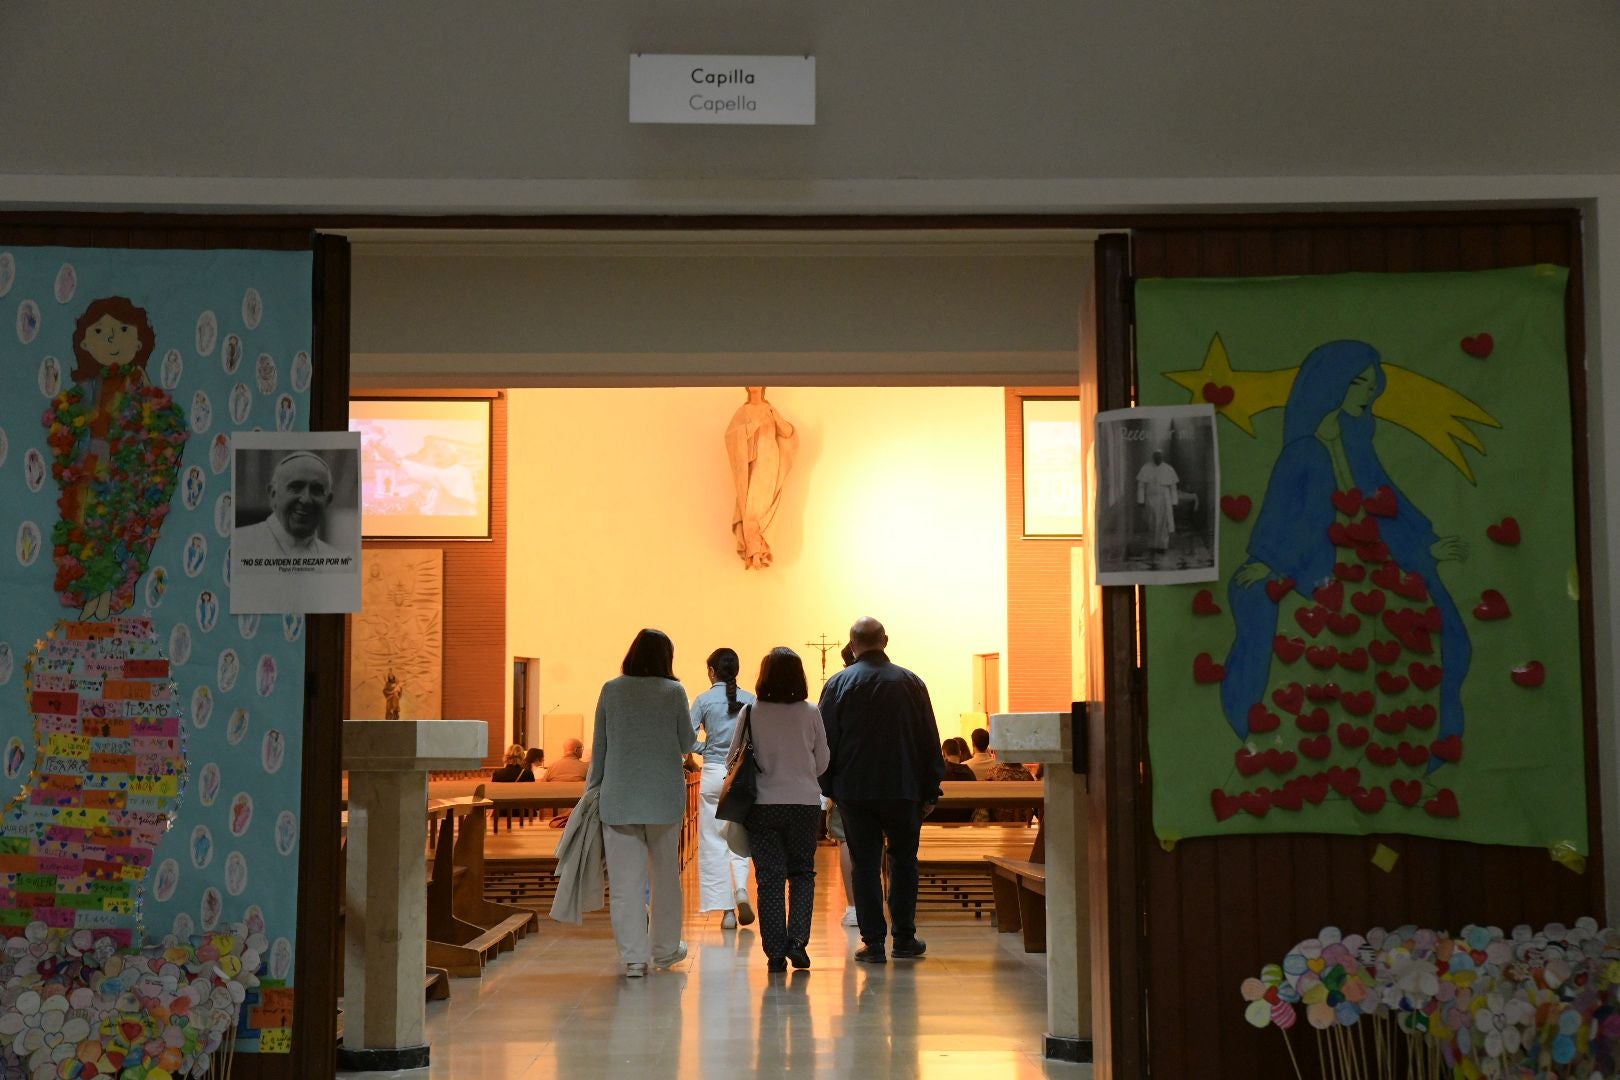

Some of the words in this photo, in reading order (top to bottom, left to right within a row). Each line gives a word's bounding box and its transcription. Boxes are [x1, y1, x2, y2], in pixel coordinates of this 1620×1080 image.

[691, 68, 755, 88] Capilla
[689, 94, 757, 114] Capella
[254, 558, 263, 566] SE
[264, 558, 292, 566] OLVIDEN
[292, 558, 301, 566] DE
[302, 558, 325, 566] REZAR
[325, 558, 340, 566] POR
